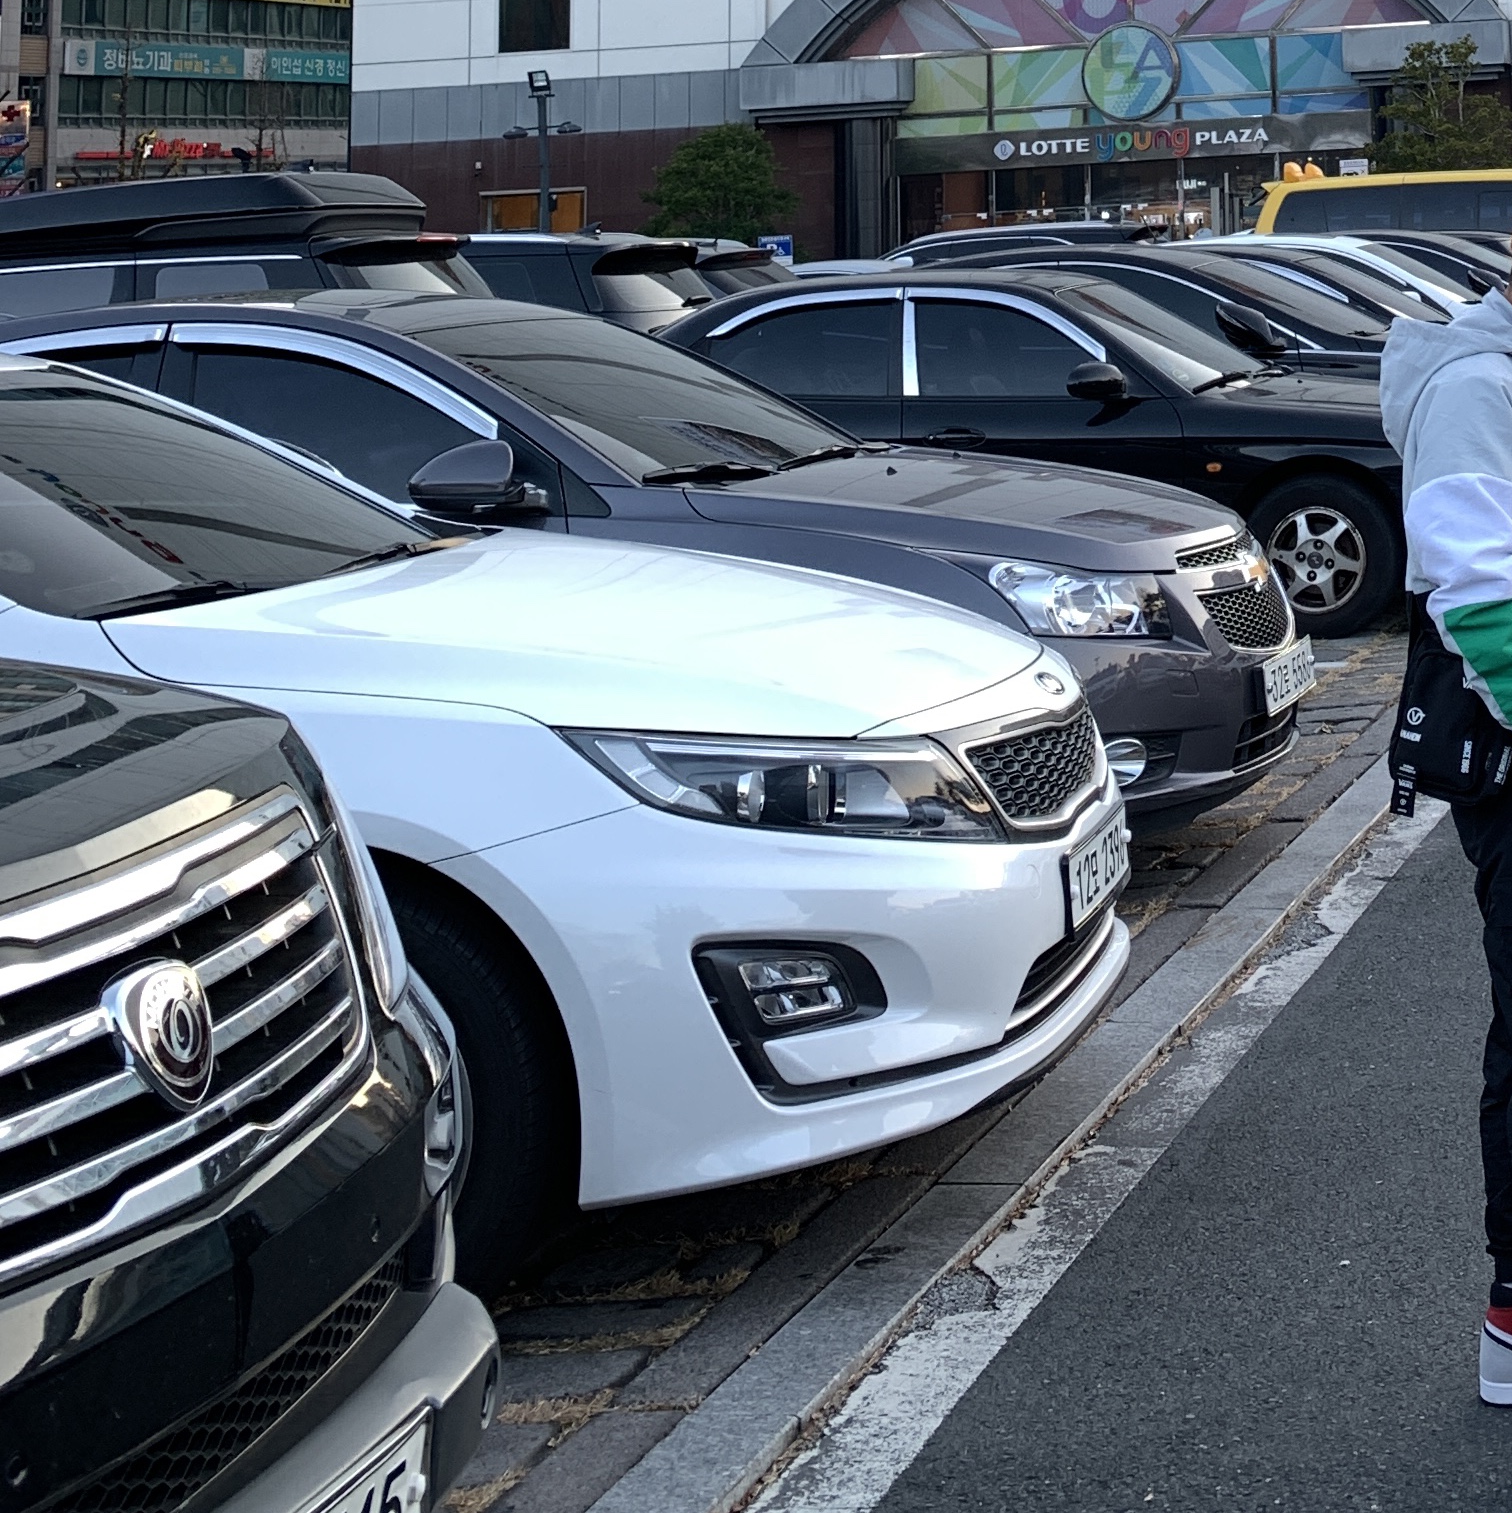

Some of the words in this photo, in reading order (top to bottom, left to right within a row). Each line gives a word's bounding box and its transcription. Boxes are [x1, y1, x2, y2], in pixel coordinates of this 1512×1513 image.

[271, 56, 301, 75] 이인섭
[304, 58, 324, 76] 신경
[1019, 138, 1090, 156] LOTTE
[1095, 127, 1190, 162] young
[1195, 128, 1269, 146] PLAZA
